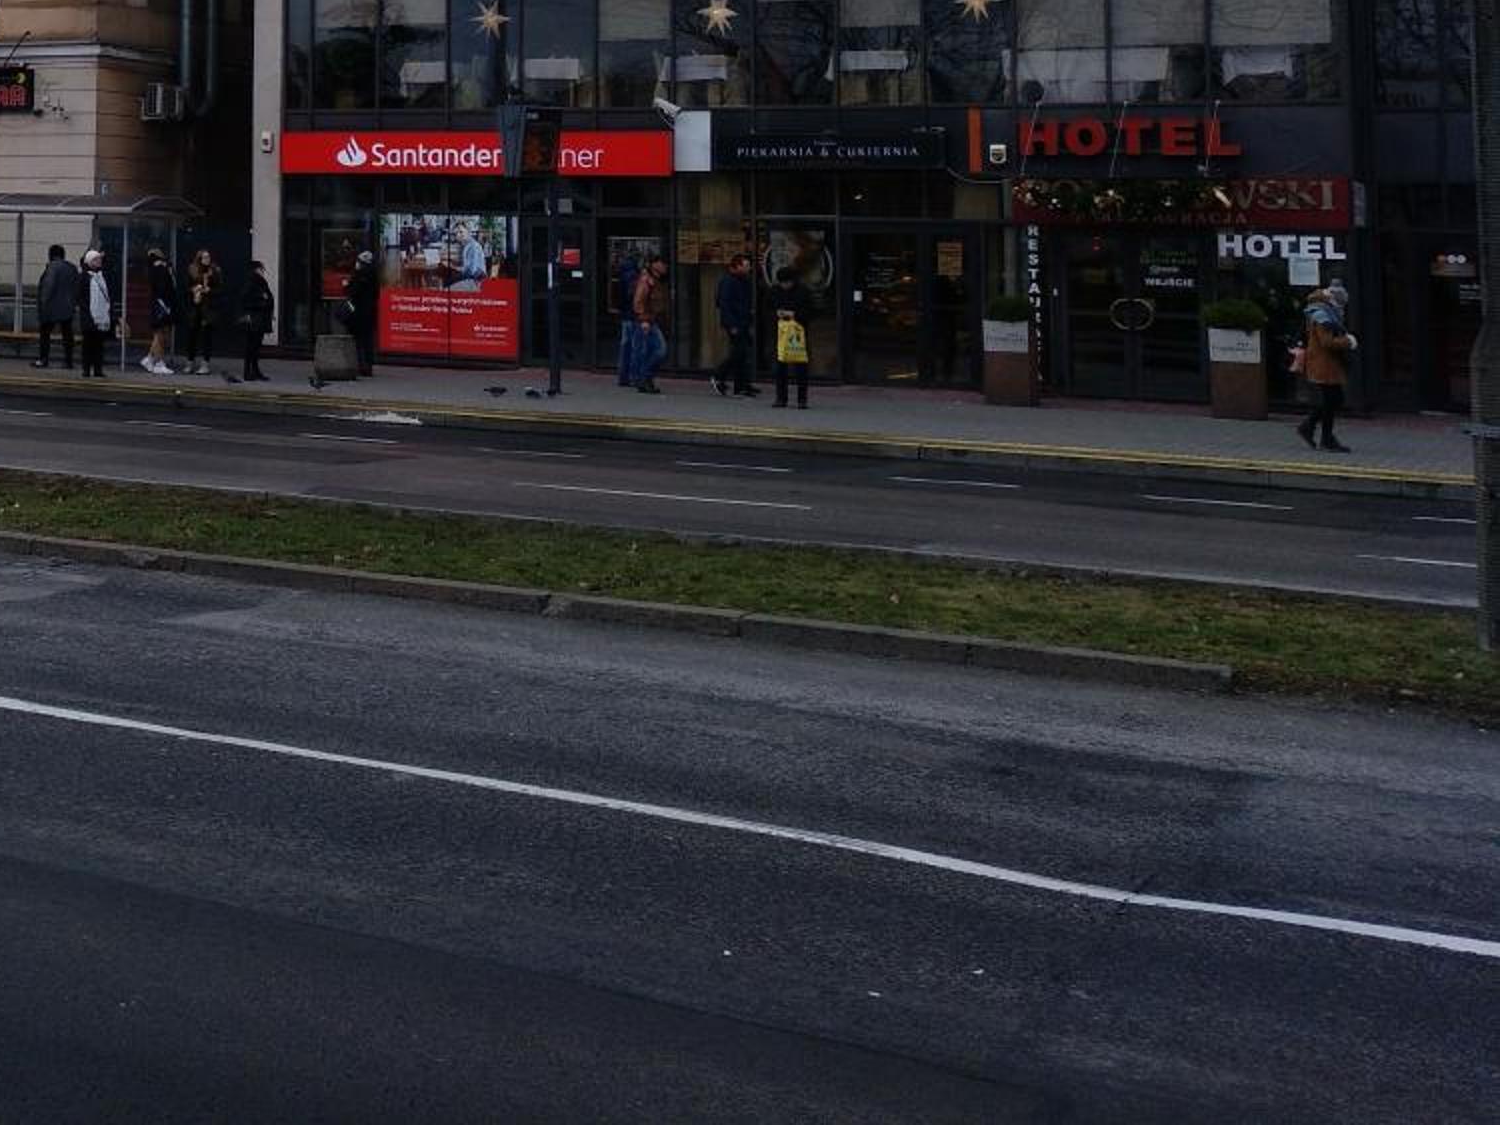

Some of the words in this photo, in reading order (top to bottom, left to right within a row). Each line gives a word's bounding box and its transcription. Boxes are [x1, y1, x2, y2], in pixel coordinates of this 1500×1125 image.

[1017, 115, 1244, 157] HOTEL
[371, 141, 502, 169] Santander
[737, 146, 813, 157] PIEKARNIA
[837, 145, 919, 157] CUKIERNIA
[1217, 234, 1347, 260] HOTEL
